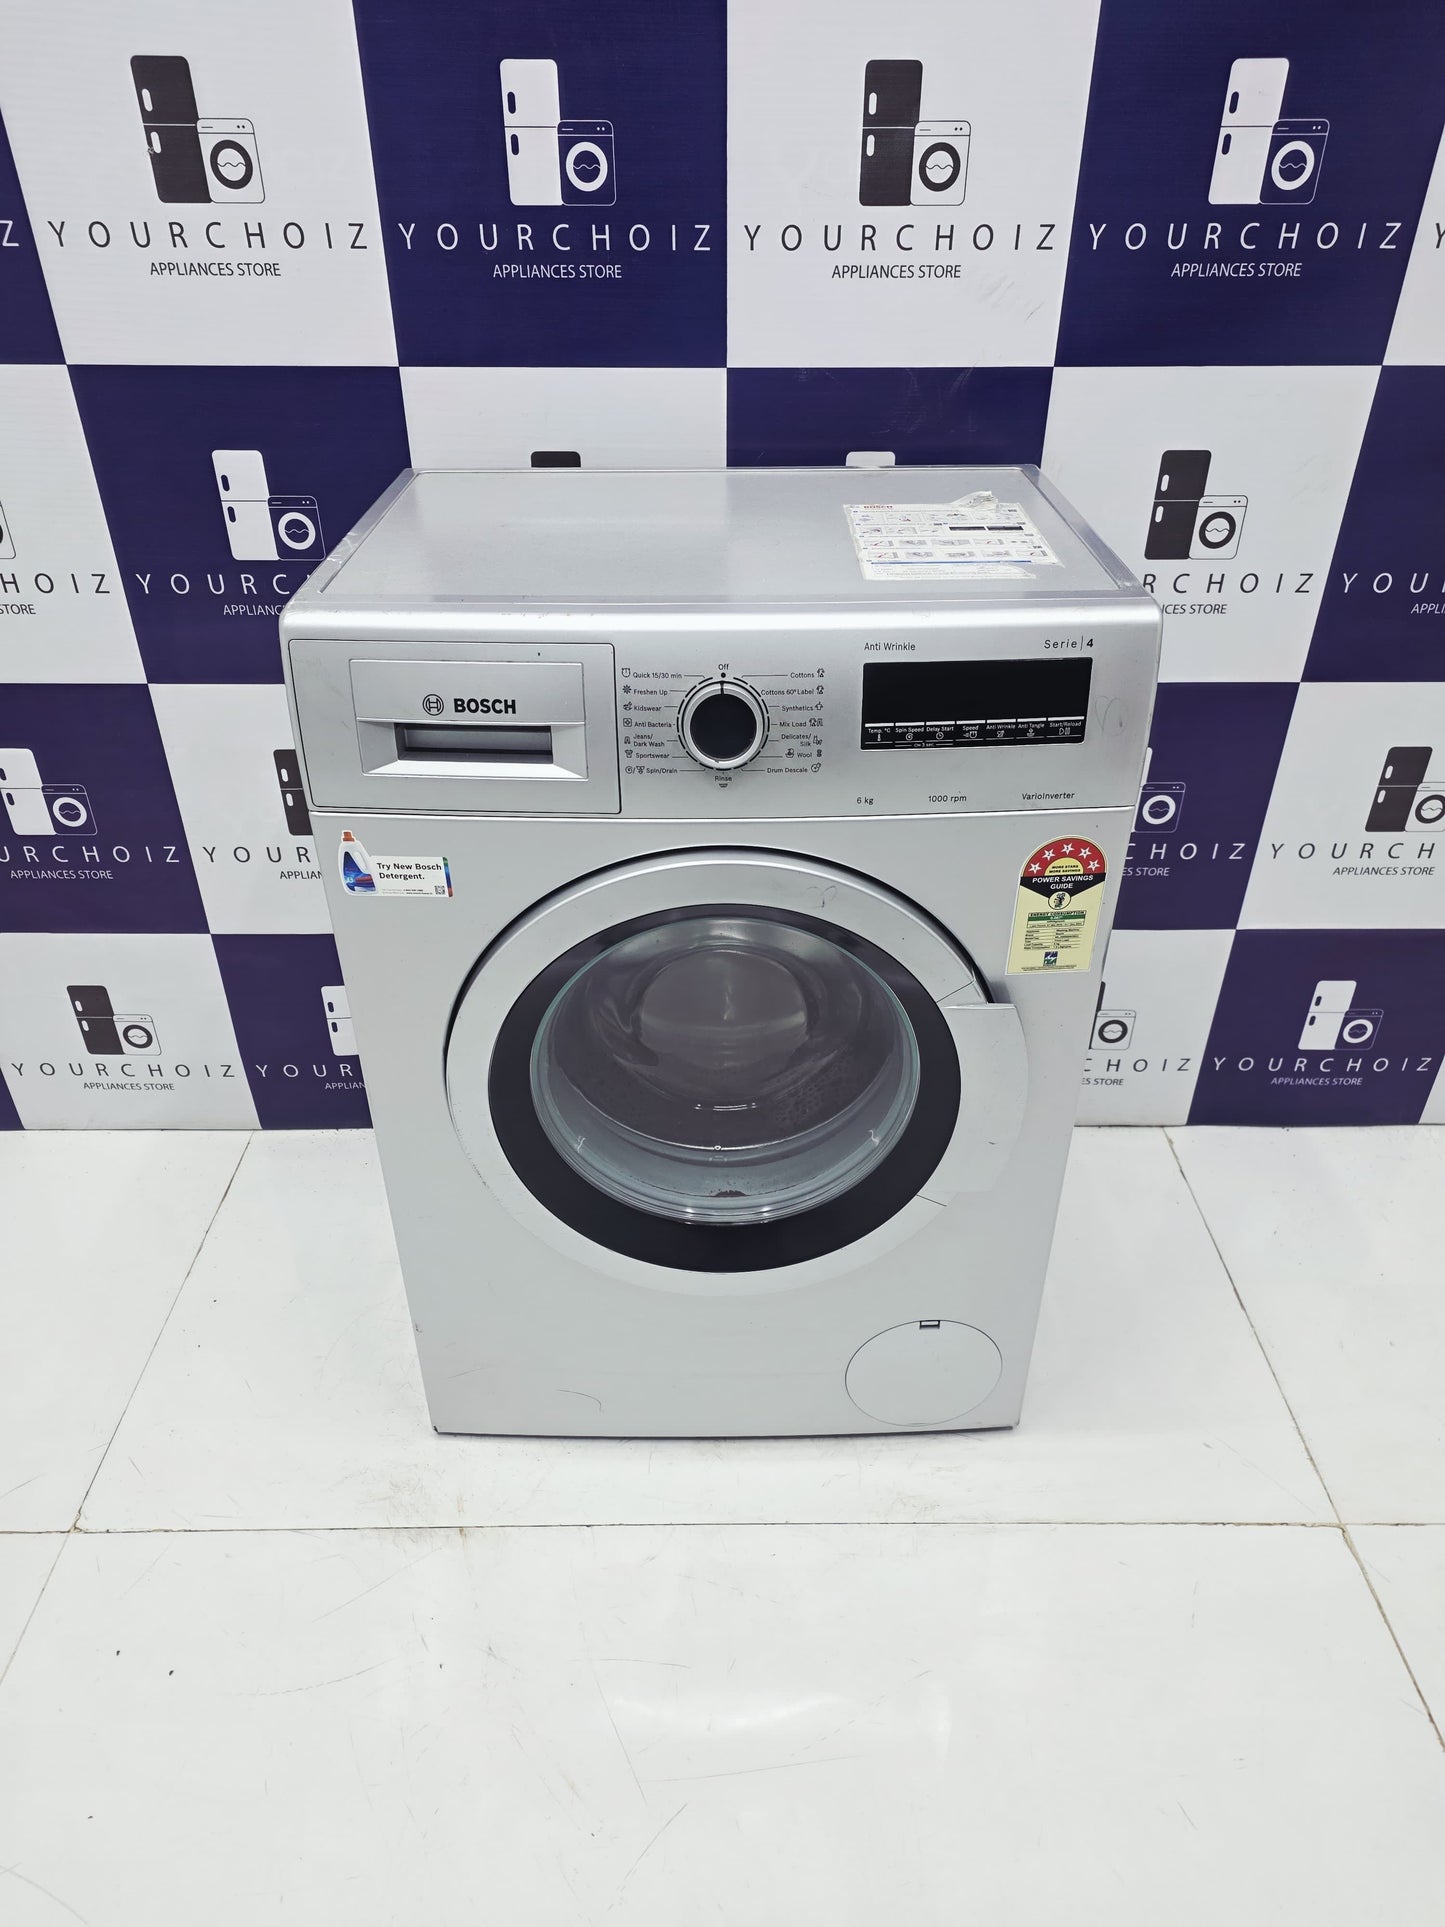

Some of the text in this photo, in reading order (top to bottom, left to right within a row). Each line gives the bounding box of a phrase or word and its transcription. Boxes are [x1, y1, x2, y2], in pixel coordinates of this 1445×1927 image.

[149, 261, 281, 277] APPLIANCES STORE
[493, 263, 622, 279] APPLIANCES STORE
[832, 263, 961, 279] APPLIANCES STORE
[1171, 262, 1302, 278] APPLIANCES STORE
[1189, 603, 1228, 615] STORE
[864, 642, 916, 651] Anti Wrinkle
[1043, 638, 1077, 649] Serie
[1086, 638, 1094, 648] 4
[718, 663, 730, 671] Off
[632, 671, 651, 679] Quick
[652, 671, 669, 680] 15/30
[790, 671, 815, 679] Cottons
[633, 688, 668, 697] Freshen Up
[797, 688, 815, 696] Label
[453, 697, 517, 715] BOSCH
[633, 704, 662, 712] Kidswear
[781, 704, 814, 713] Synthetics
[635, 752, 670, 760] Sportswear
[796, 751, 813, 759] Wool
[646, 767, 678, 775] Spin/Drain
[864, 797, 874, 805] kg
[928, 795, 967, 804] 1000 rpm
[376, 862, 391, 871] Try
[415, 863, 442, 871] Bosch
[1332, 866, 1436, 876] APPLIANCES STORE
[10, 869, 114, 880] APPLIANCES STORE
[379, 872, 425, 881] Detergent.
[1135, 867, 1170, 877] STORE
[1032, 874, 1094, 884] POWER SAVINGS
[1050, 882, 1074, 890] GUIDE
[83, 1081, 176, 1091] APPLIANCES STORE
[1093, 1077, 1125, 1086] STORE
[1271, 1077, 1363, 1086] APPLIANCES STORE
